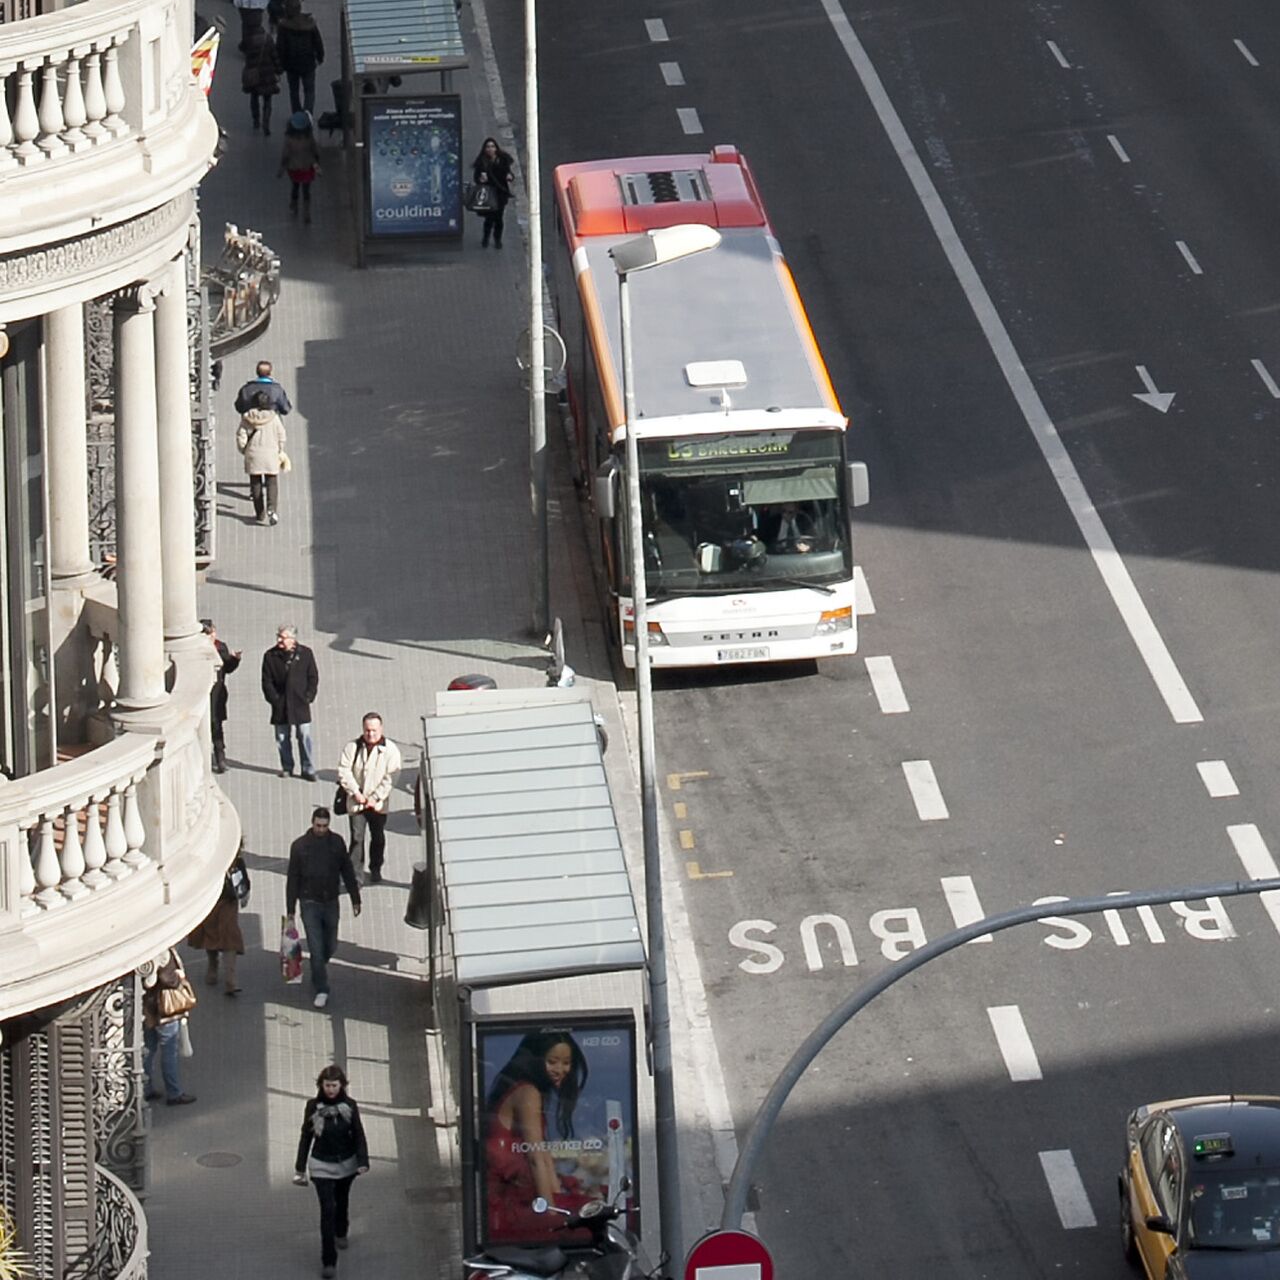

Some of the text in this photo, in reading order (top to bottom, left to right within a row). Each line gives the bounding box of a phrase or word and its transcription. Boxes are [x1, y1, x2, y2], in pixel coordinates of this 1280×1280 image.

[376, 205, 442, 219] couldina
[703, 629, 779, 641] SETRA
[728, 908, 928, 974] BUS
